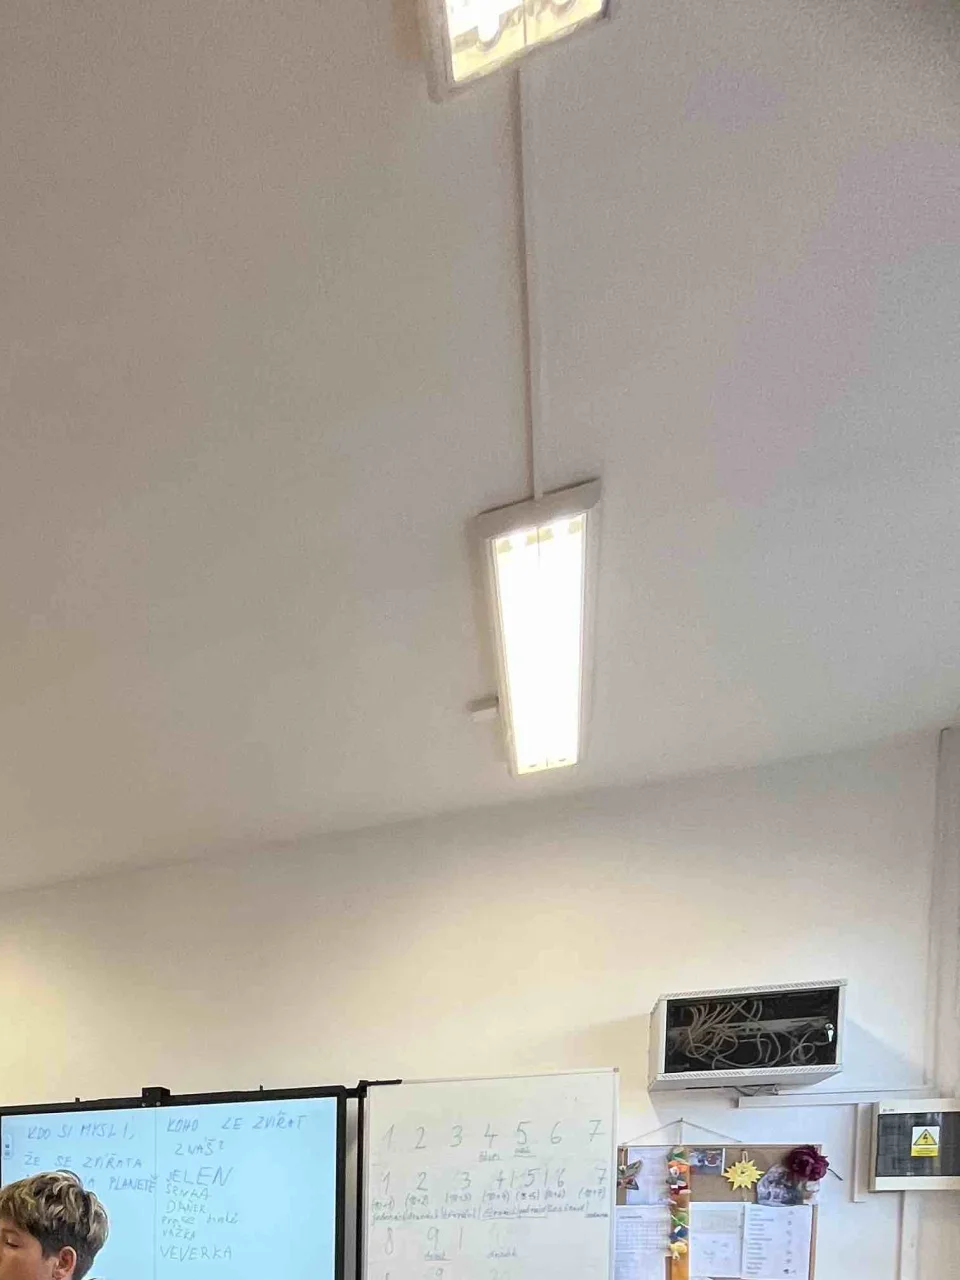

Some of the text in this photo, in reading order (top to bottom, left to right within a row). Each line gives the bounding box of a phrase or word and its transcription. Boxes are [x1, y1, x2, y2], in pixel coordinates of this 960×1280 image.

[27, 1125, 51, 1140] KDO
[57, 1123, 74, 1139] SI
[166, 1116, 199, 1133] KOHO
[381, 1119, 606, 1150] 1 2 3 4 5 6 7
[54, 1155, 73, 1168] SE
[165, 1165, 234, 1187] JELEN
[381, 1170, 391, 1195] 1
[416, 1171, 429, 1192] 2
[459, 1171, 472, 1190] 3
[523, 1167, 541, 1188] 5
[555, 1167, 566, 1188] 6
[594, 1166, 608, 1186] 7
[427, 1226, 440, 1251] 9
[159, 1244, 233, 1263] VEVERKA
